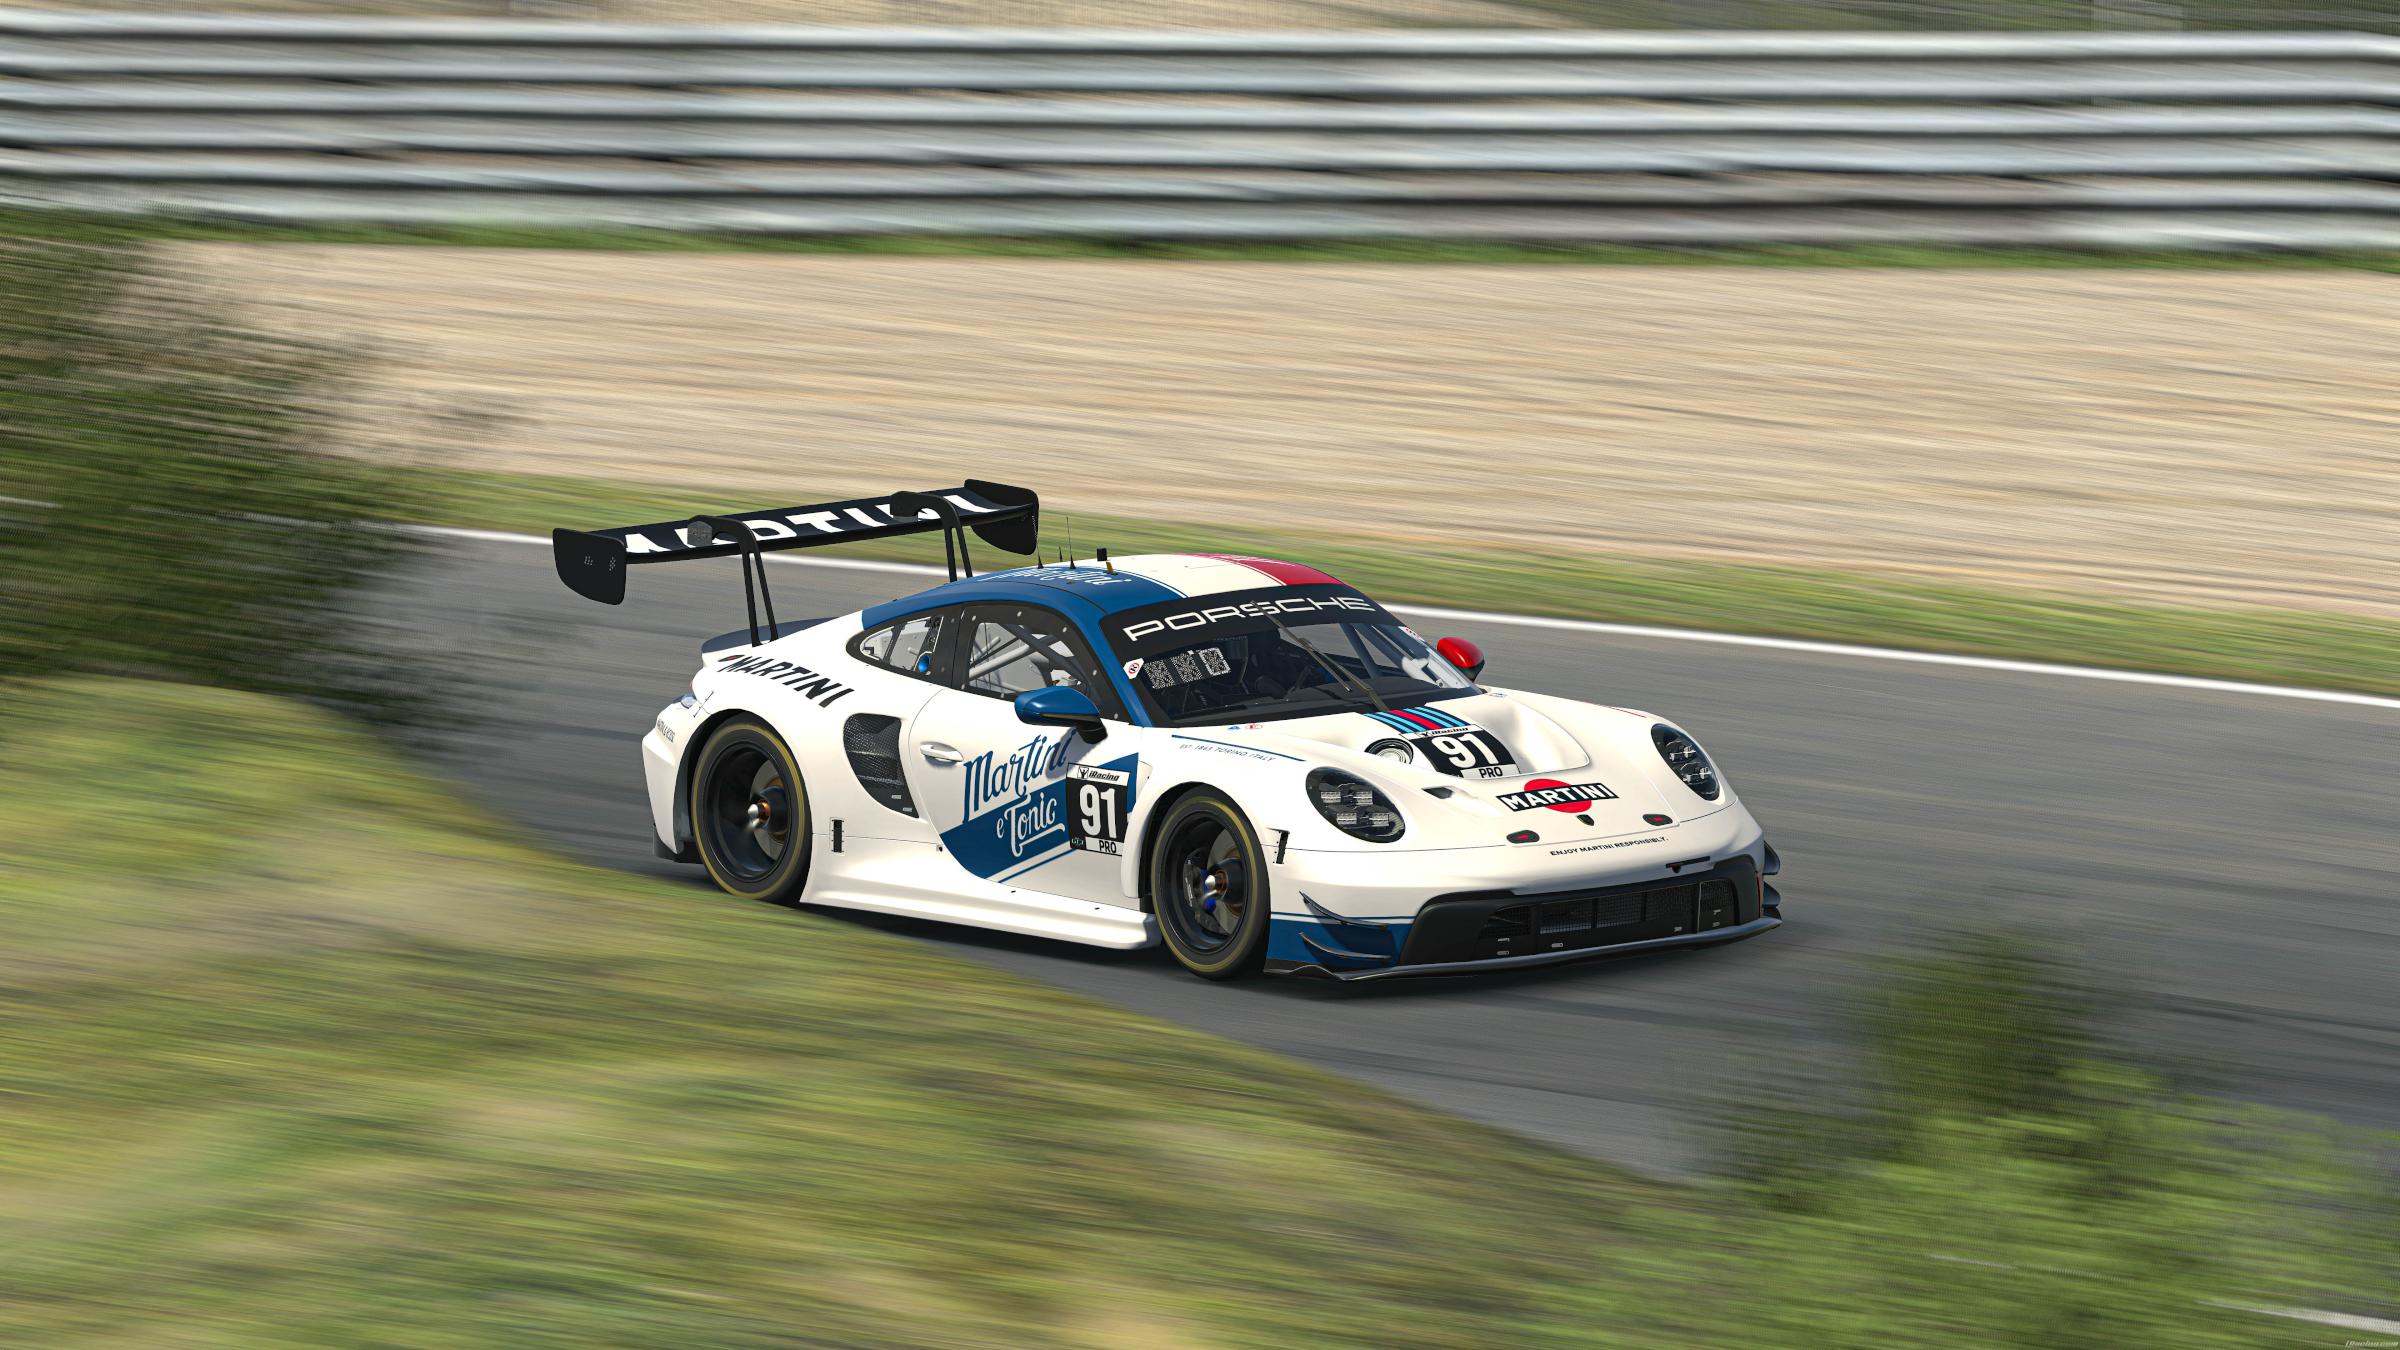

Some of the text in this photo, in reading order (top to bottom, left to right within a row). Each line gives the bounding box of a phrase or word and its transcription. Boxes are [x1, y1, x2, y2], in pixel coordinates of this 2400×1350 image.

[1123, 597, 1376, 642] PORSCHE
[716, 655, 855, 709] MARTINI
[1214, 747, 1248, 757] TORINO
[1249, 753, 1276, 762] ITALY
[1431, 733, 1499, 769] 91
[963, 727, 1077, 824] Martini
[1088, 769, 1120, 782] iRacing
[1479, 766, 1503, 779] PRO
[1080, 784, 1117, 839] 91
[1500, 783, 1615, 810] MARTINI
[996, 792, 1065, 858] e Tonic
[1099, 840, 1117, 854] PRO
[1550, 836, 1669, 856] ENJOY MARTINI RESPONSIBLY.
